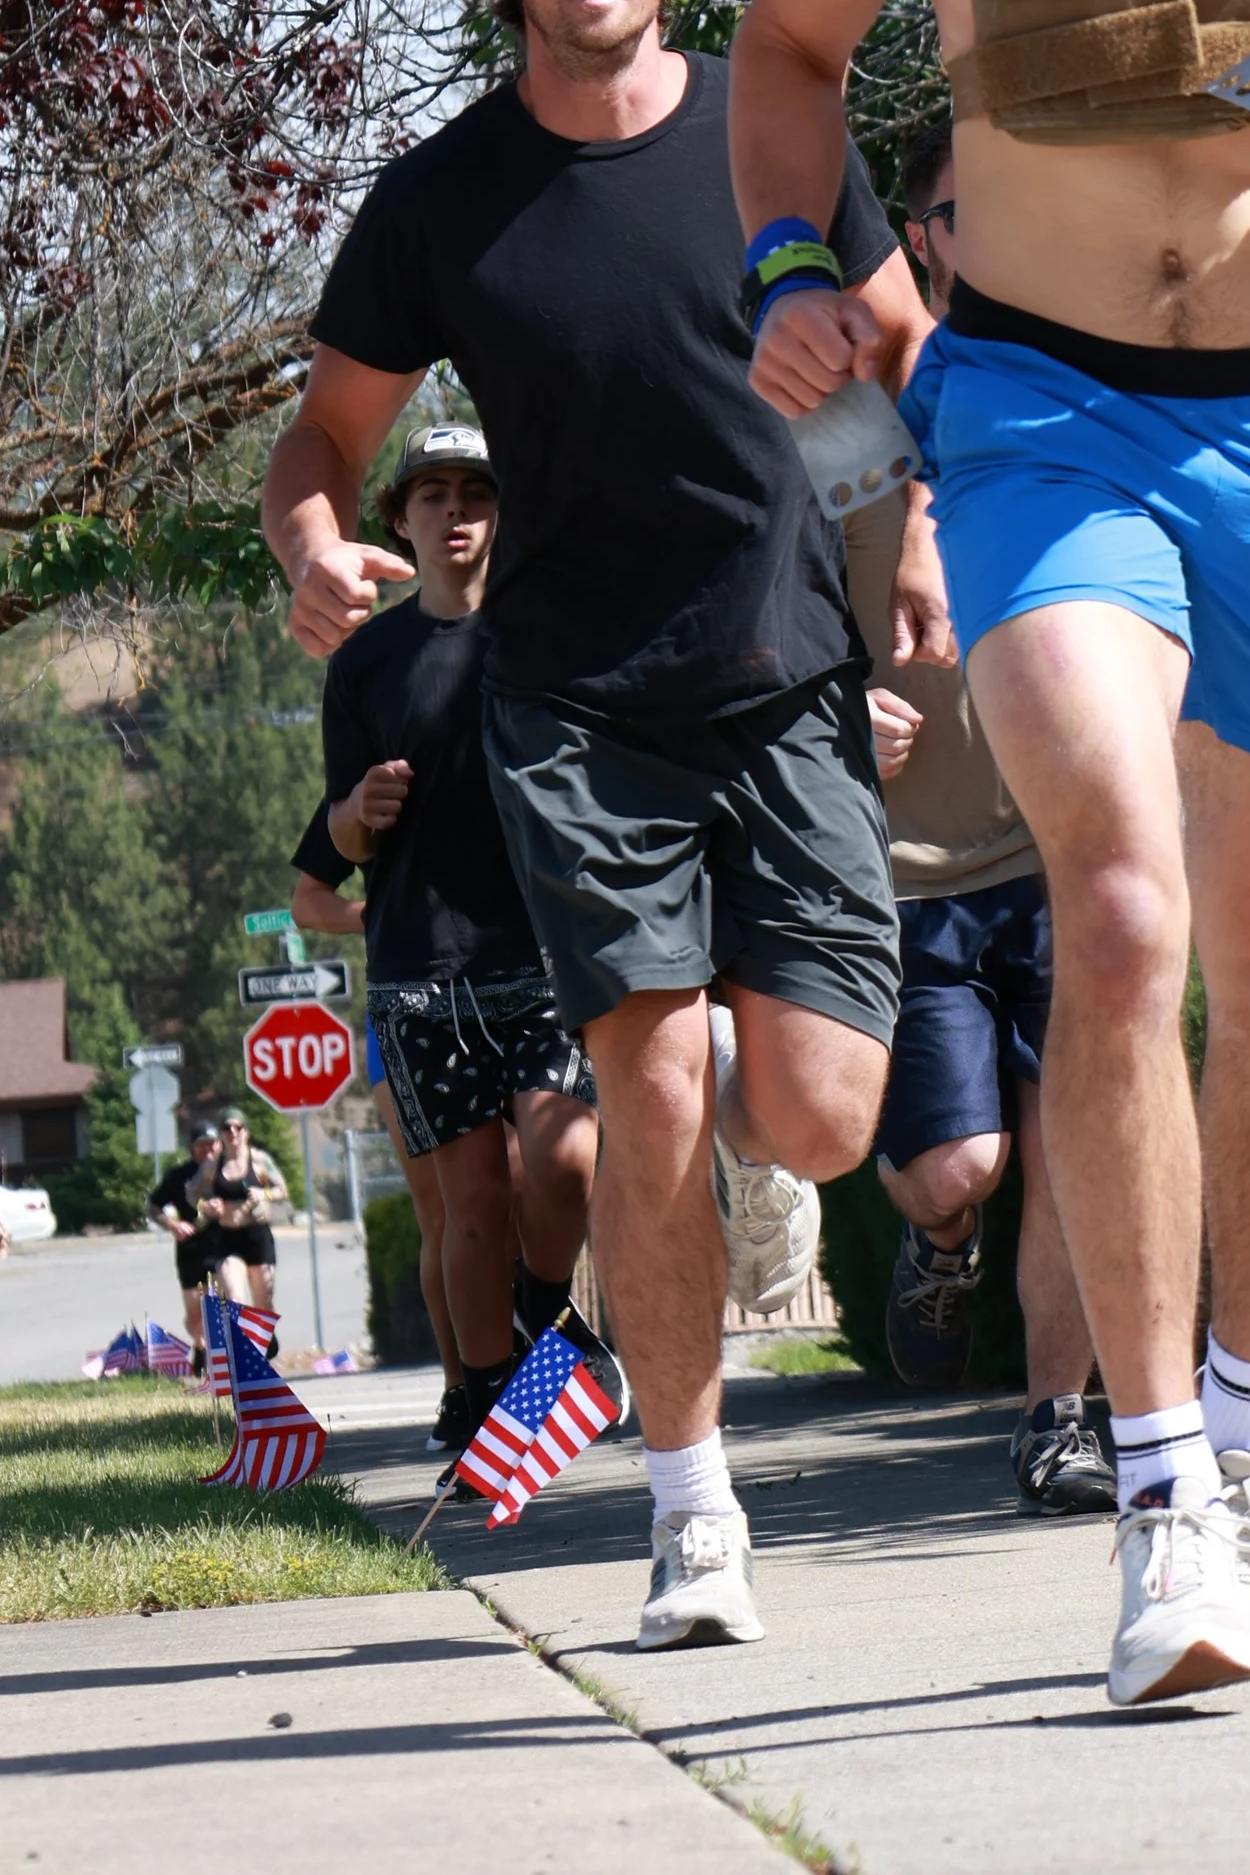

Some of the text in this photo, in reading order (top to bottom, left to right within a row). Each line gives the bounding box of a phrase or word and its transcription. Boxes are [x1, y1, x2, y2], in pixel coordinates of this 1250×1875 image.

[252, 972, 318, 995] ONE WAY
[253, 1033, 346, 1082] STOP
